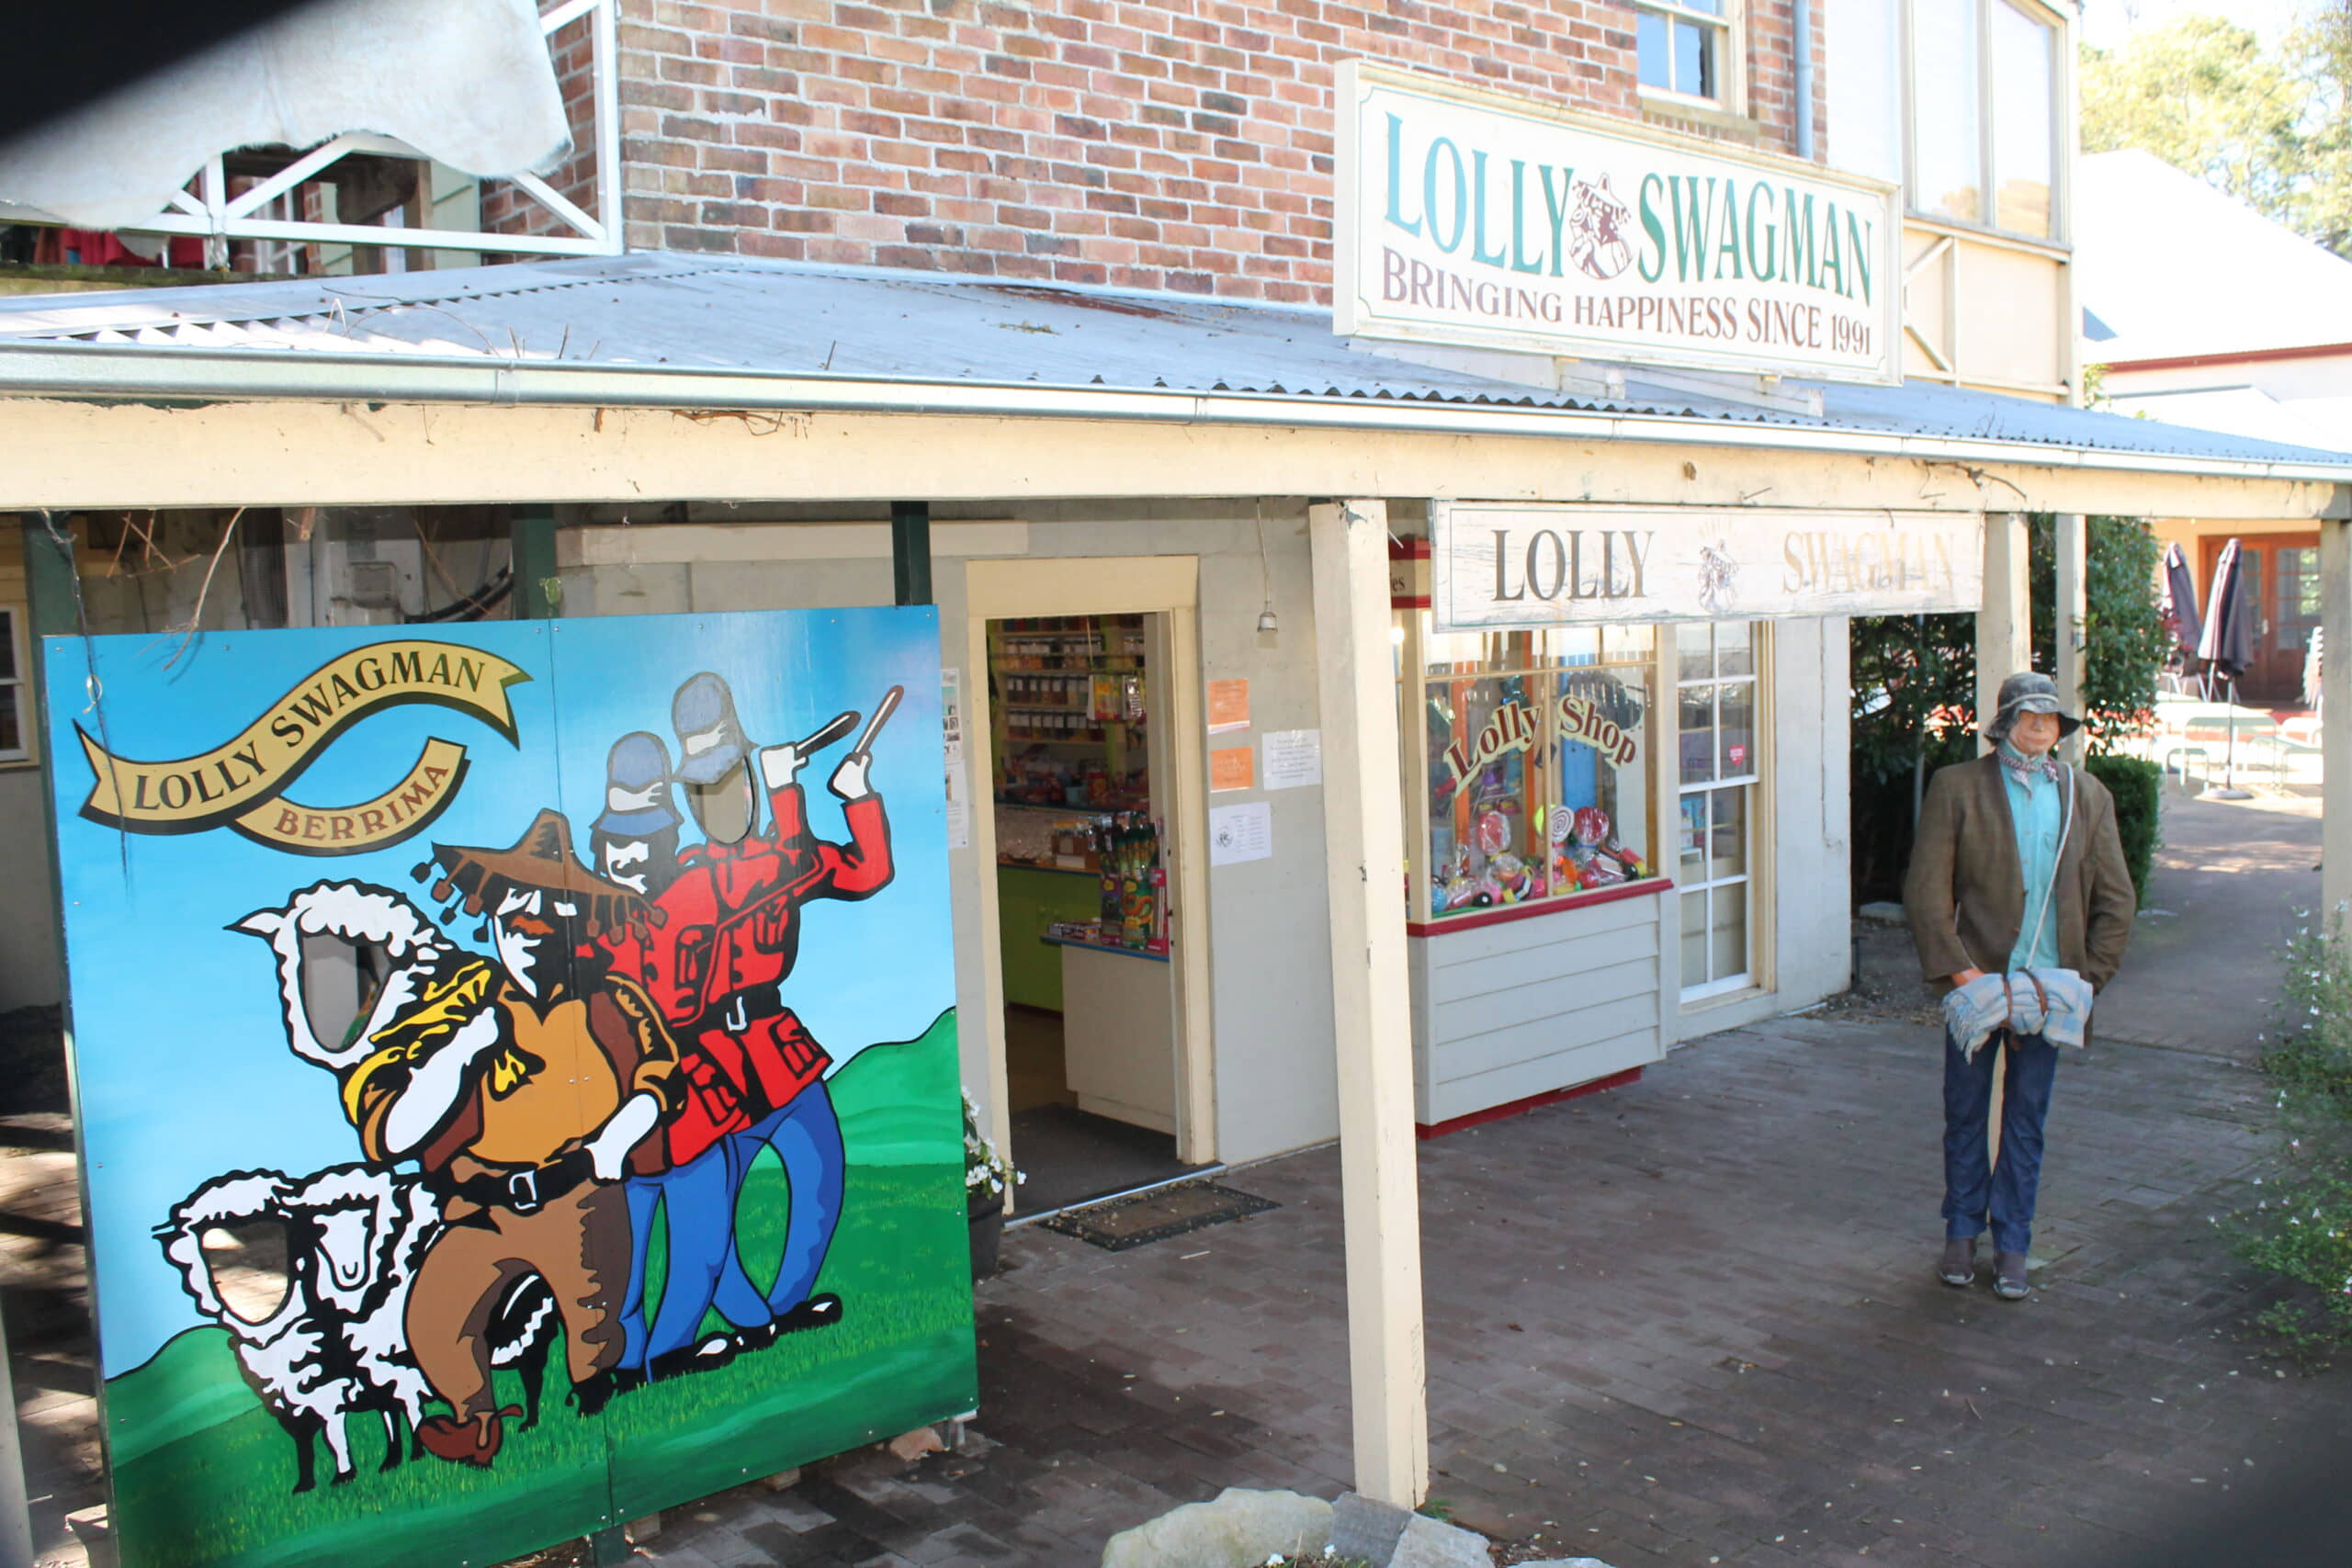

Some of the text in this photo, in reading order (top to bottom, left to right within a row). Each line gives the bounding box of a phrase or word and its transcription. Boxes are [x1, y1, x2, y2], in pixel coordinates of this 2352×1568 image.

[1384, 111, 1872, 308] LOLLY SWAGMAN
[1383, 245, 1871, 355] BRINGING HAPPINESS SINCE 1991
[1492, 528, 1956, 602] LOLLY SWAGMAN
[133, 650, 485, 810] LOLLY SWAGMAN
[1443, 694, 1637, 790] Lolly Shop
[273, 764, 449, 840] BERRIMA
